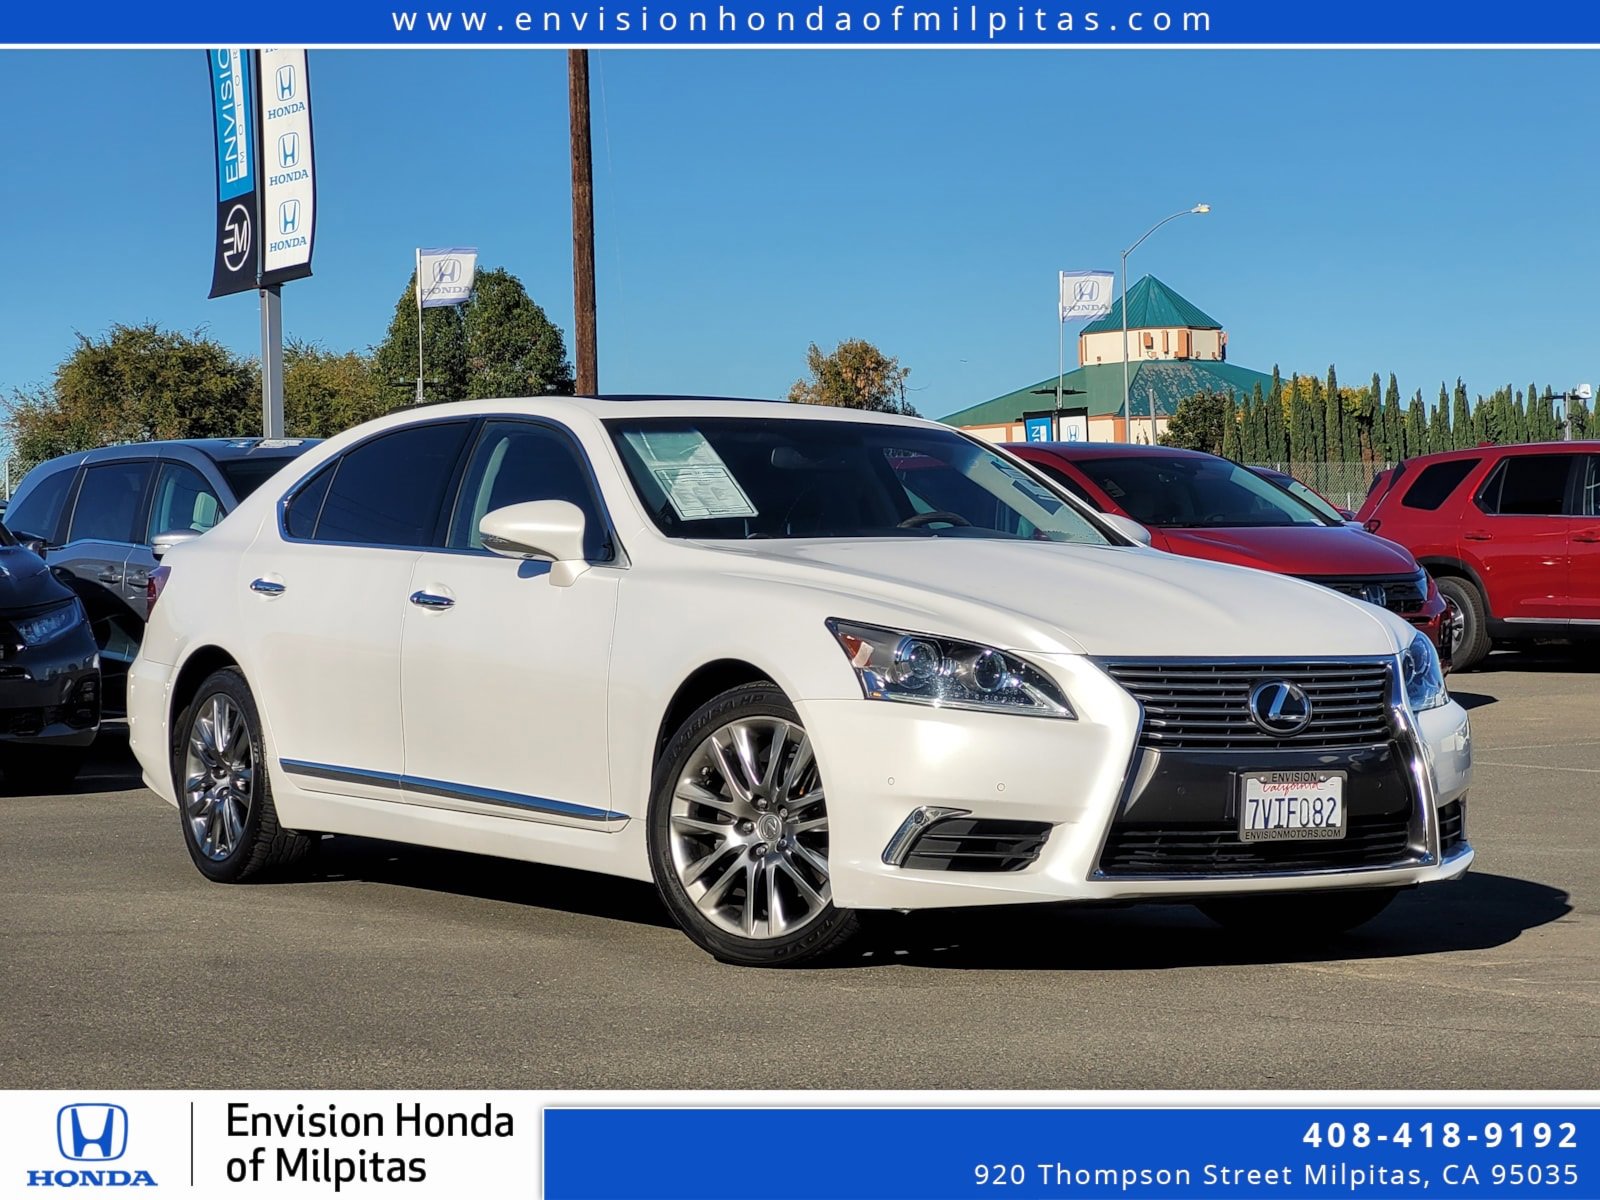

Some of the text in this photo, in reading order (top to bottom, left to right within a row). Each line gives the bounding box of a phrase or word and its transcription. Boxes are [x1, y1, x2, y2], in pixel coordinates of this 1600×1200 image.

[267, 102, 306, 120] HONDA
[269, 169, 309, 186] HONDA
[269, 236, 307, 253] HONDA
[1271, 772, 1318, 783] ENVISION
[1248, 797, 1338, 830] 7VIF082
[1245, 829, 1342, 840] ENVISIONMOTORS.COM
